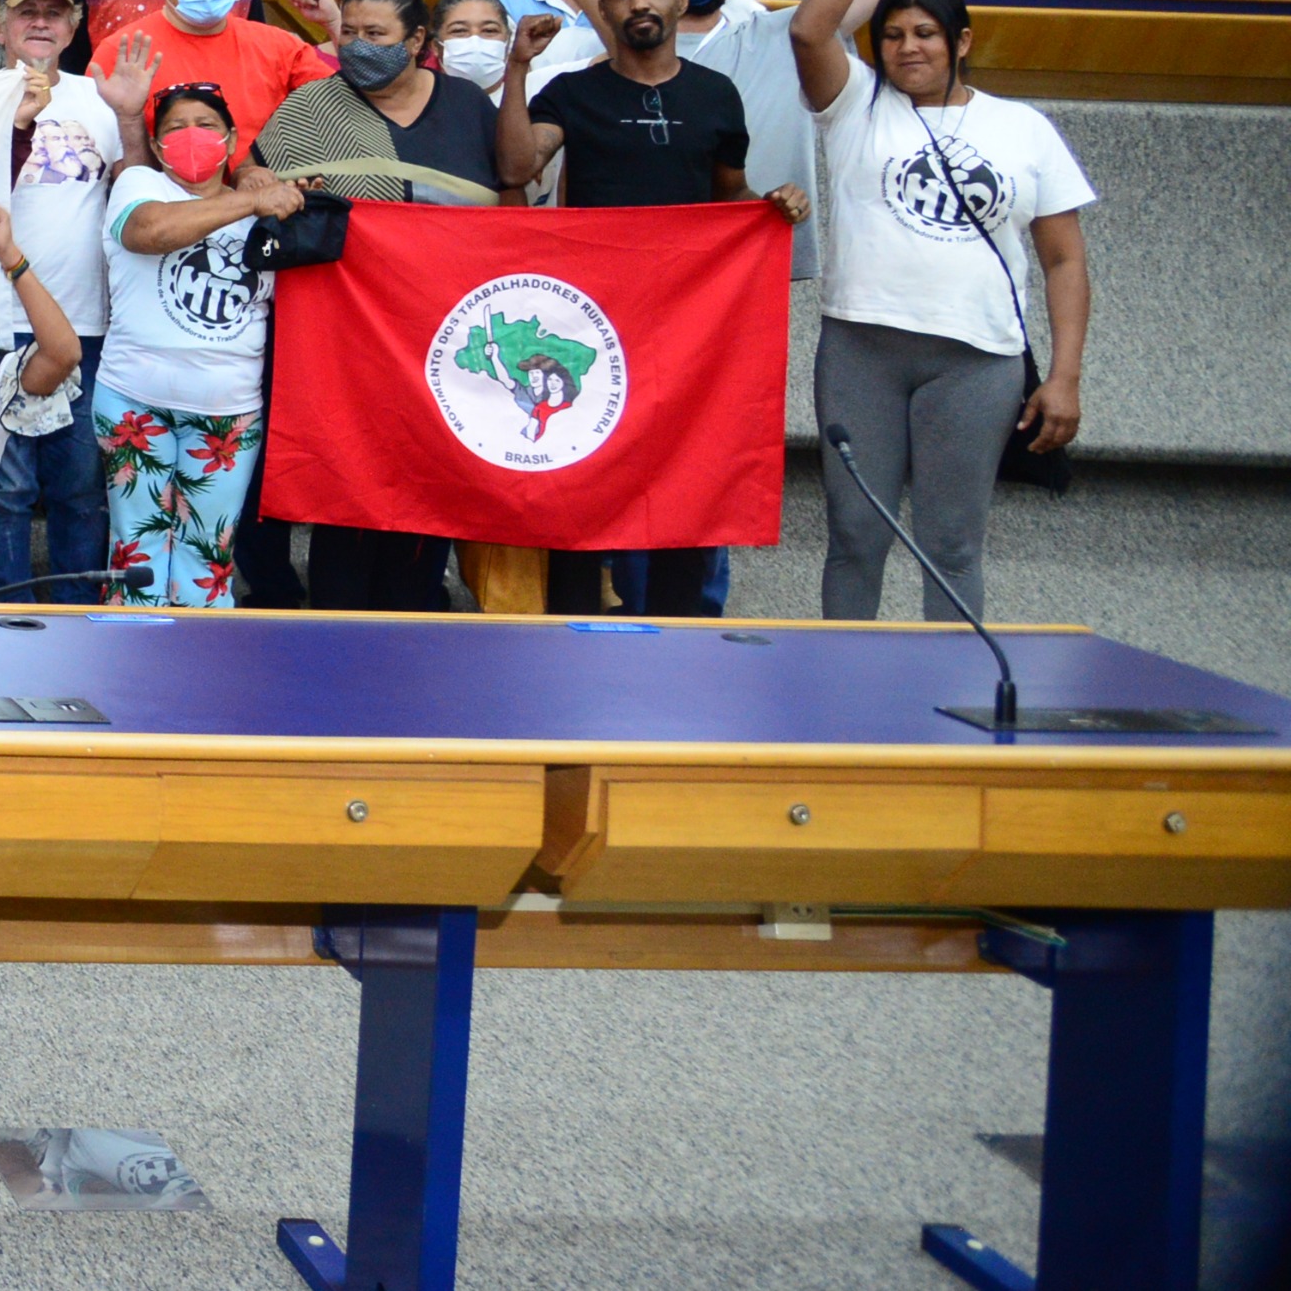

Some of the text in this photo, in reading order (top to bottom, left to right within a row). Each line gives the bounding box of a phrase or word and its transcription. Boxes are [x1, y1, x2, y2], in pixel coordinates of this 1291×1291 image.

[430, 278, 622, 435] MOVIMENTO DOS TRABALHADORES RURAIS SEM TERRA
[504, 451, 554, 465] BRASIL
